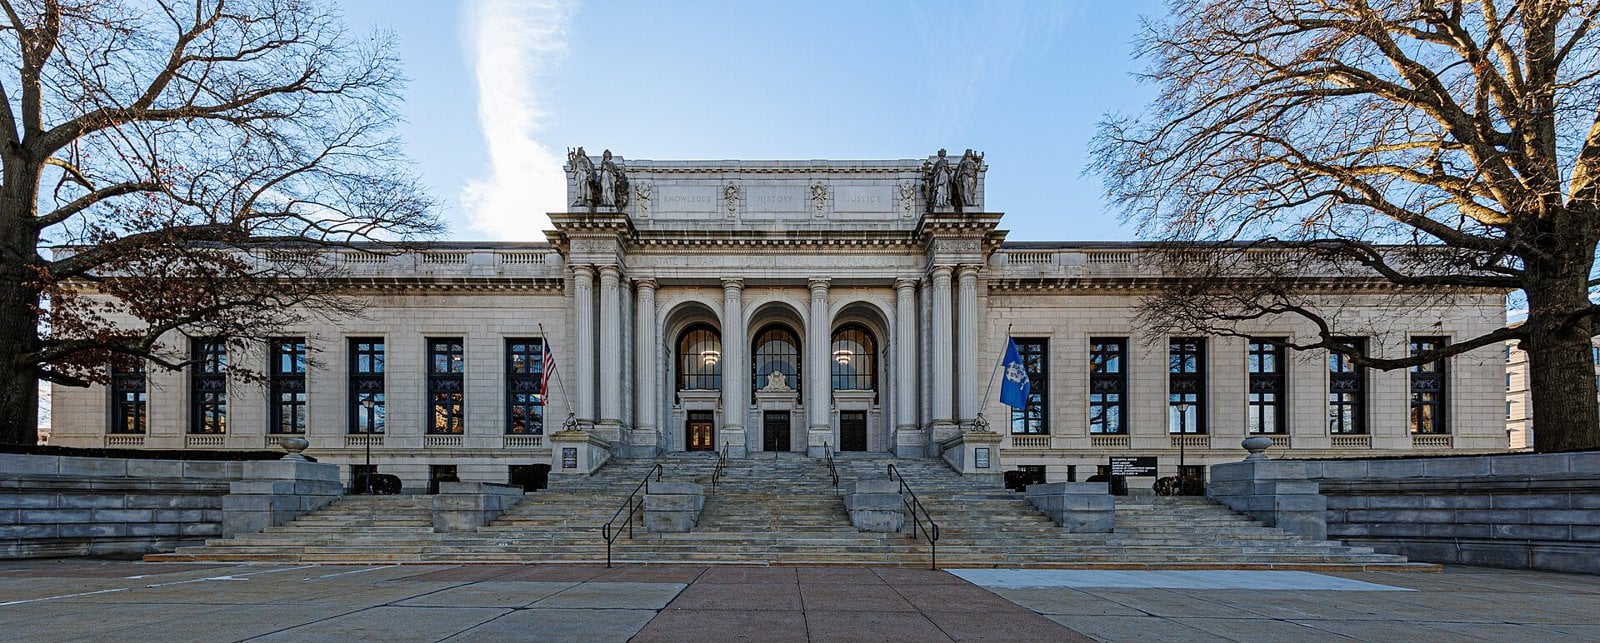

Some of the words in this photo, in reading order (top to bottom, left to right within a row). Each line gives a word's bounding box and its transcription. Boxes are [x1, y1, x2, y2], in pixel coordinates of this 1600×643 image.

[663, 195, 712, 203] KNOWLEDGE
[757, 195, 793, 203] HISTORY
[844, 195, 882, 203] JUSTICE
